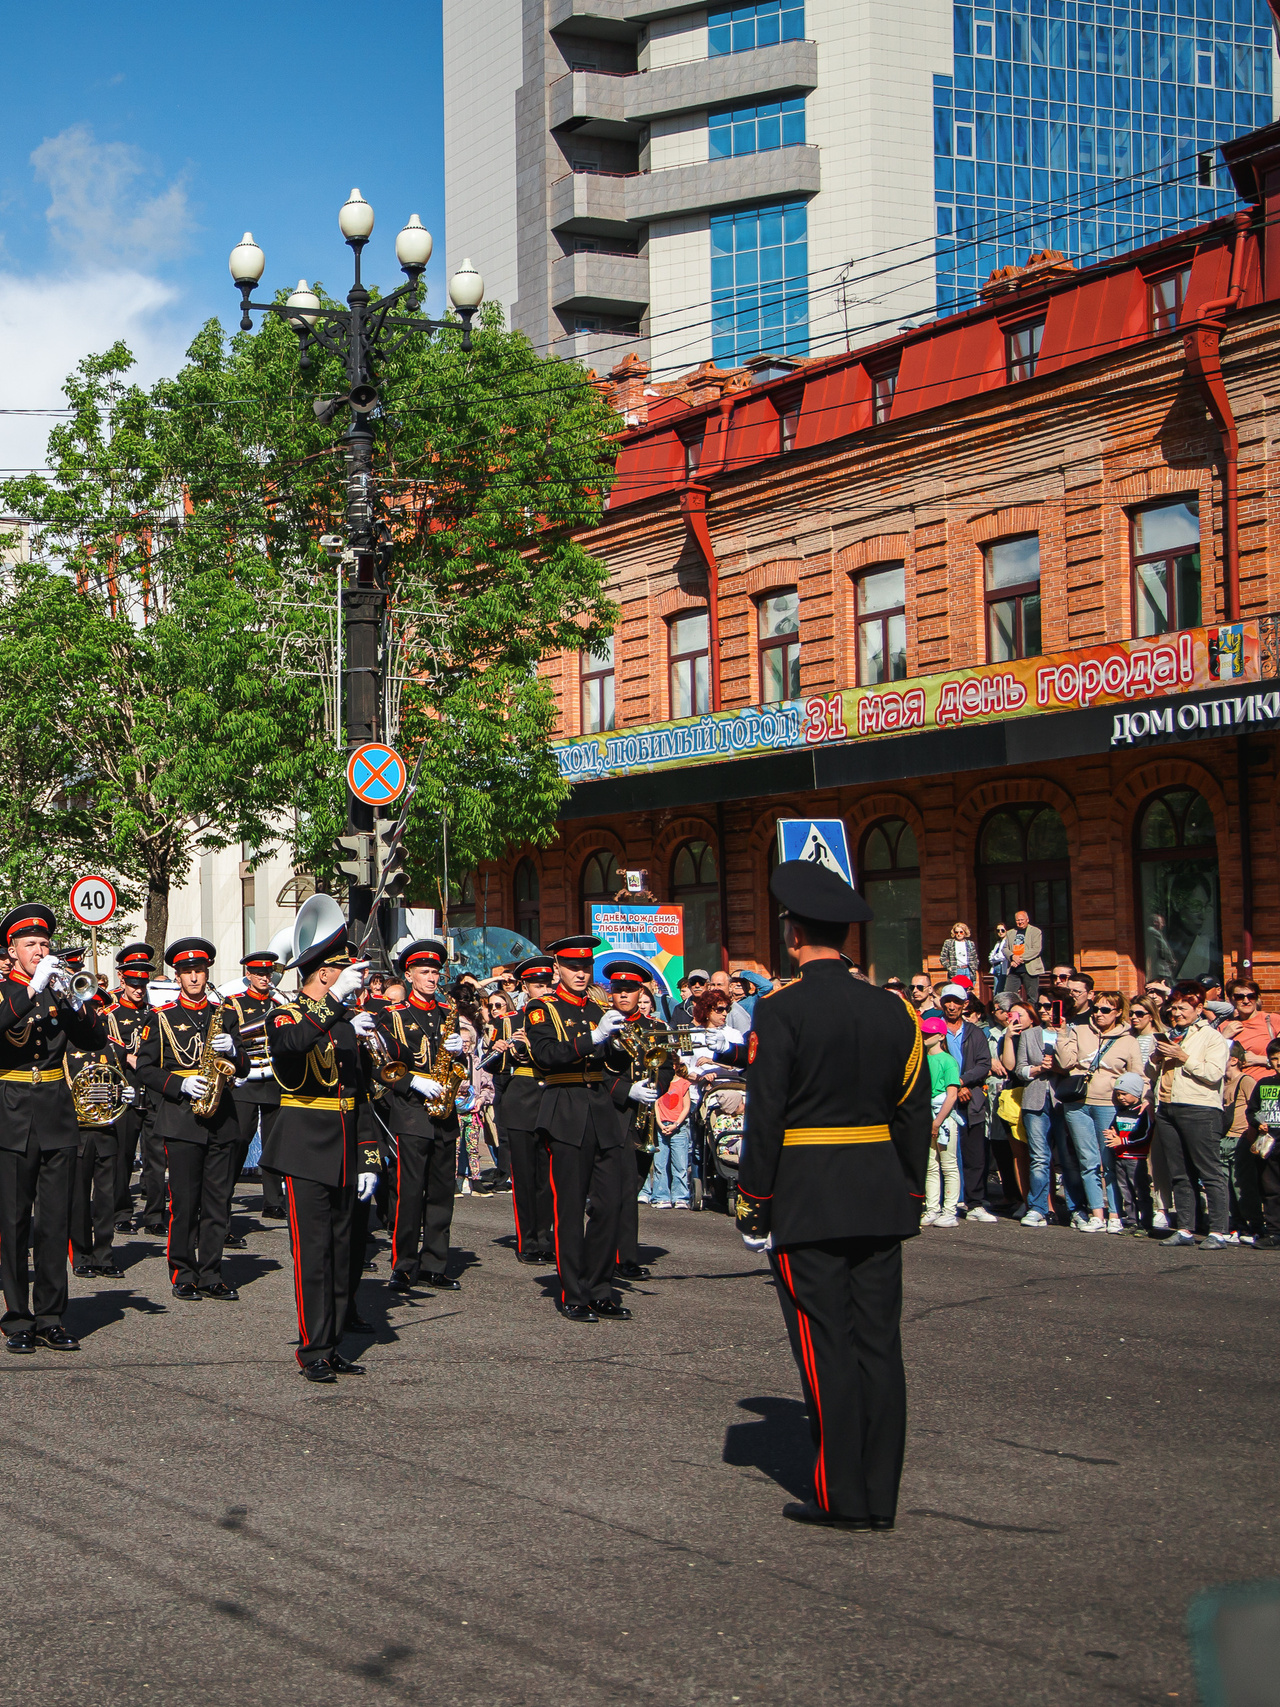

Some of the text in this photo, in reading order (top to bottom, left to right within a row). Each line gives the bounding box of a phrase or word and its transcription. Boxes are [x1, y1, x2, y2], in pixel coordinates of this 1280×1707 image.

[806, 632, 1193, 743] 31 мая день города!
[1111, 707, 1173, 745] ДОМ
[551, 708, 799, 775] КОМ, ЛЮБИМЫЙ ГОРОД!
[81, 891, 105, 910] 40
[595, 911, 679, 924] С ДНЁМ РОЖДЕНИЯ,
[598, 923, 679, 935] ЛЮБИМЫЙ ГОРОД!
